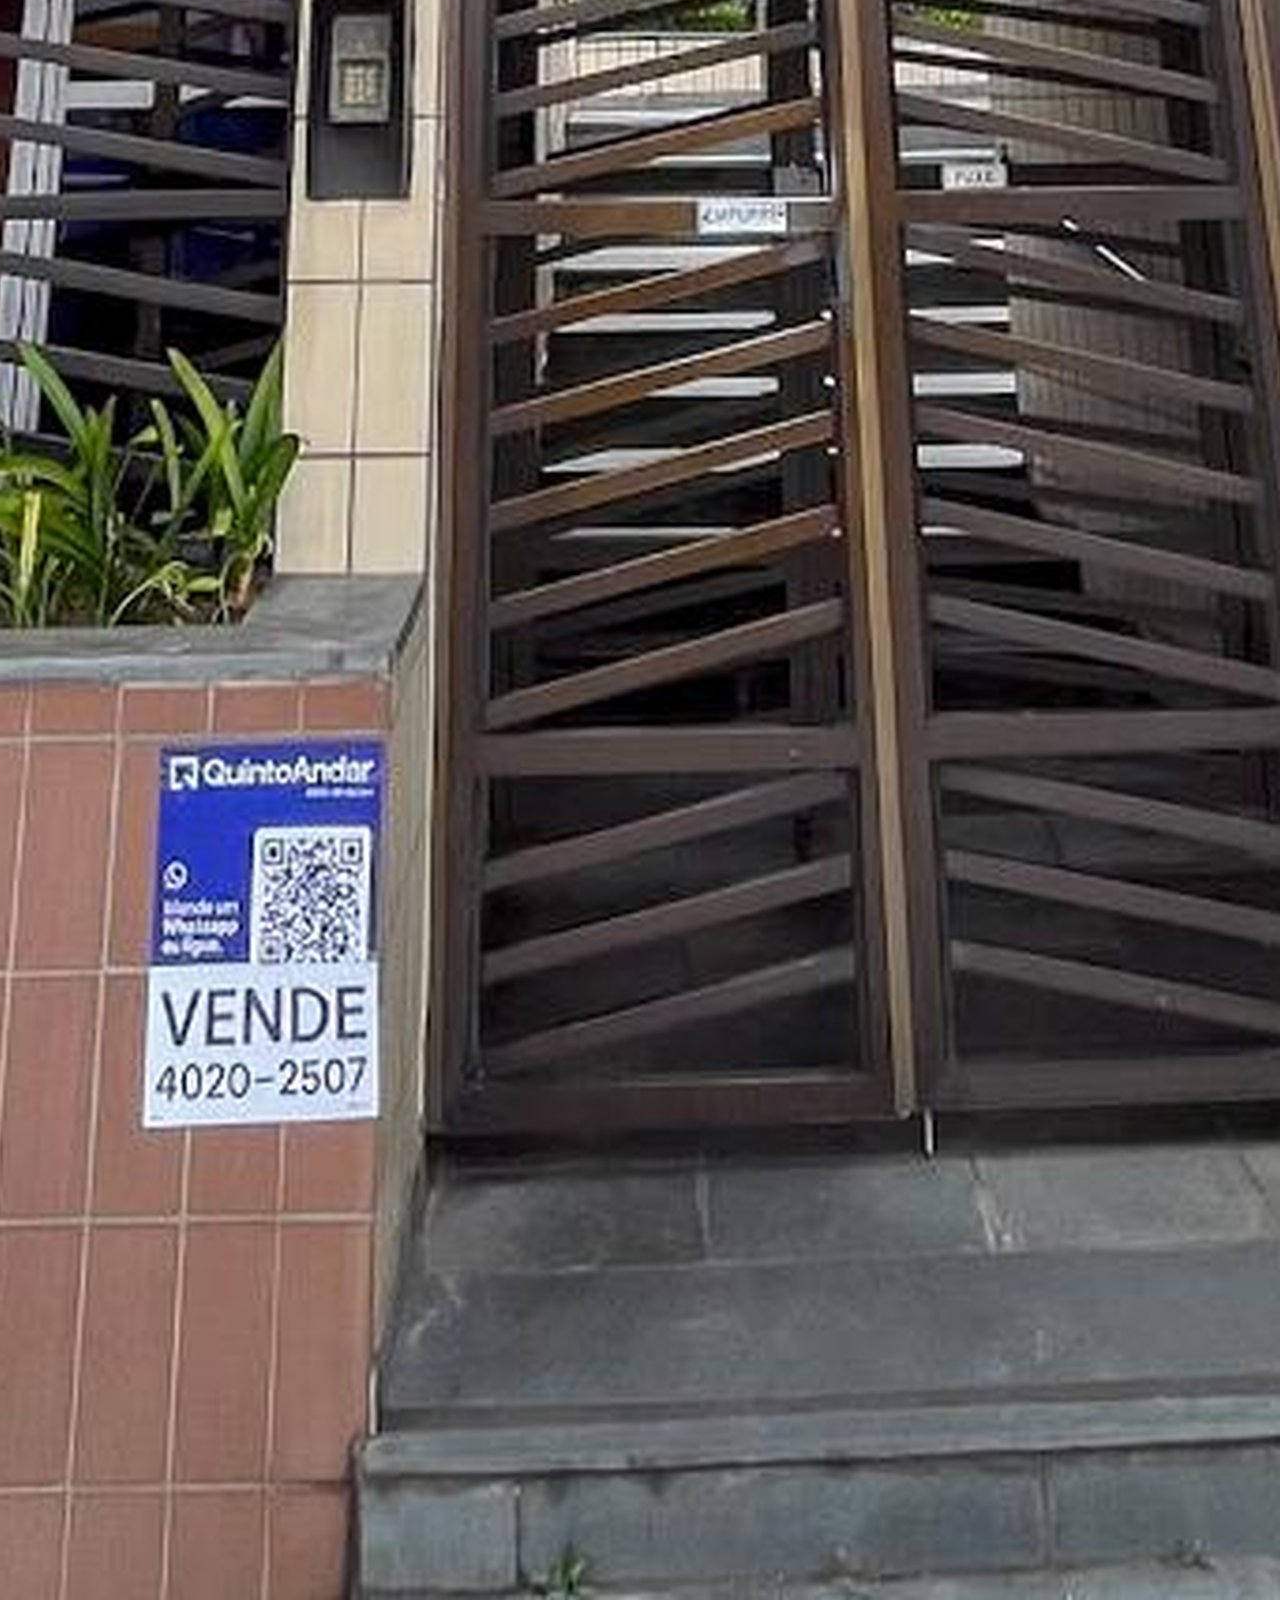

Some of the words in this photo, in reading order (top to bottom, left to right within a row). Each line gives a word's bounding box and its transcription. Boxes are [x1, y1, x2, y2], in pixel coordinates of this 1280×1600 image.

[203, 755, 374, 788] QuintoAndar
[162, 986, 367, 1047] VENDE
[155, 1056, 368, 1101] 4020-2507
